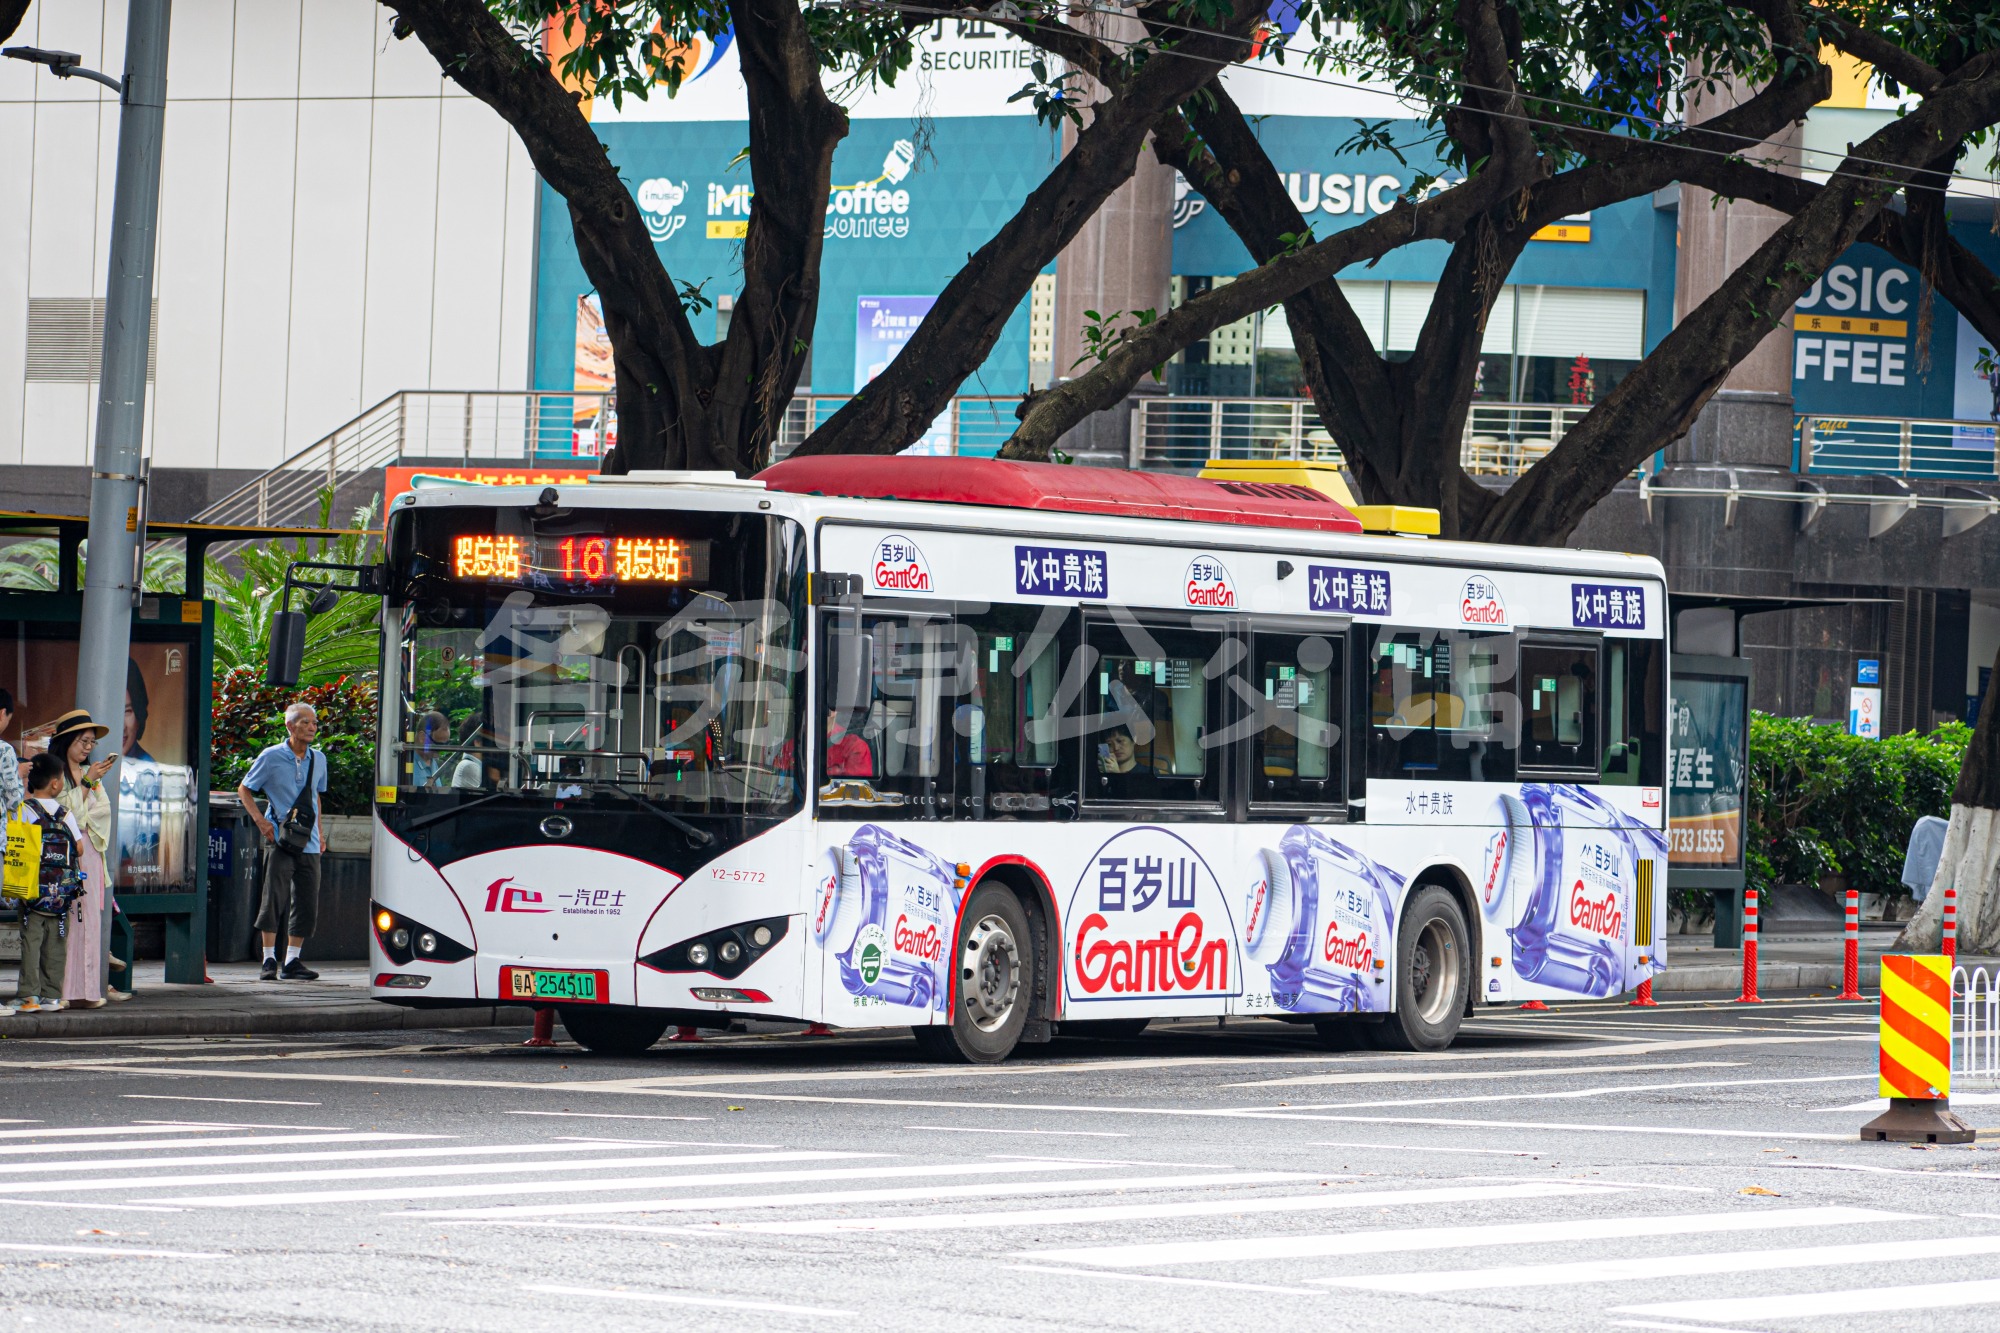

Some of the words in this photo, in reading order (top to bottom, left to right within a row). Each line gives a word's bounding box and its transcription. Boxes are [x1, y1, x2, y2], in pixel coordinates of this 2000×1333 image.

[920, 49, 1045, 71] SECURITIES
[1279, 172, 1401, 214] USIC
[1795, 337, 1907, 386] FFEE
[560, 538, 605, 581] 16
[881, 543, 916, 563] 百岁山
[875, 561, 929, 590] Ganten
[1020, 550, 1104, 594] 水中贵族
[1192, 563, 1223, 582] 百岁山
[1187, 579, 1234, 607] Ganten
[1312, 569, 1388, 611] 水中贵族
[1467, 583, 1494, 600] 百岁山
[1462, 598, 1504, 624] Ganten
[1575, 587, 1642, 626] 水中贵族
[1405, 790, 1454, 815] 水中贵族
[1695, 828, 1725, 854] 1555
[1595, 843, 1621, 878] 百岁山
[711, 868, 767, 884] Y2-5772
[1095, 855, 1197, 913] 百岁山
[558, 888, 627, 907] 一汽巴士
[562, 907, 598, 915] Established
[605, 908, 621, 916] 1952
[917, 885, 941, 912] 百岁山
[1348, 889, 1371, 919] 百岁山
[1570, 879, 1622, 940] Ganten
[894, 913, 942, 962] Ganten
[1075, 911, 1229, 993] Ganten
[1324, 921, 1373, 973] Ganten
[1246, 993, 1299, 1008] 安全才能回家
